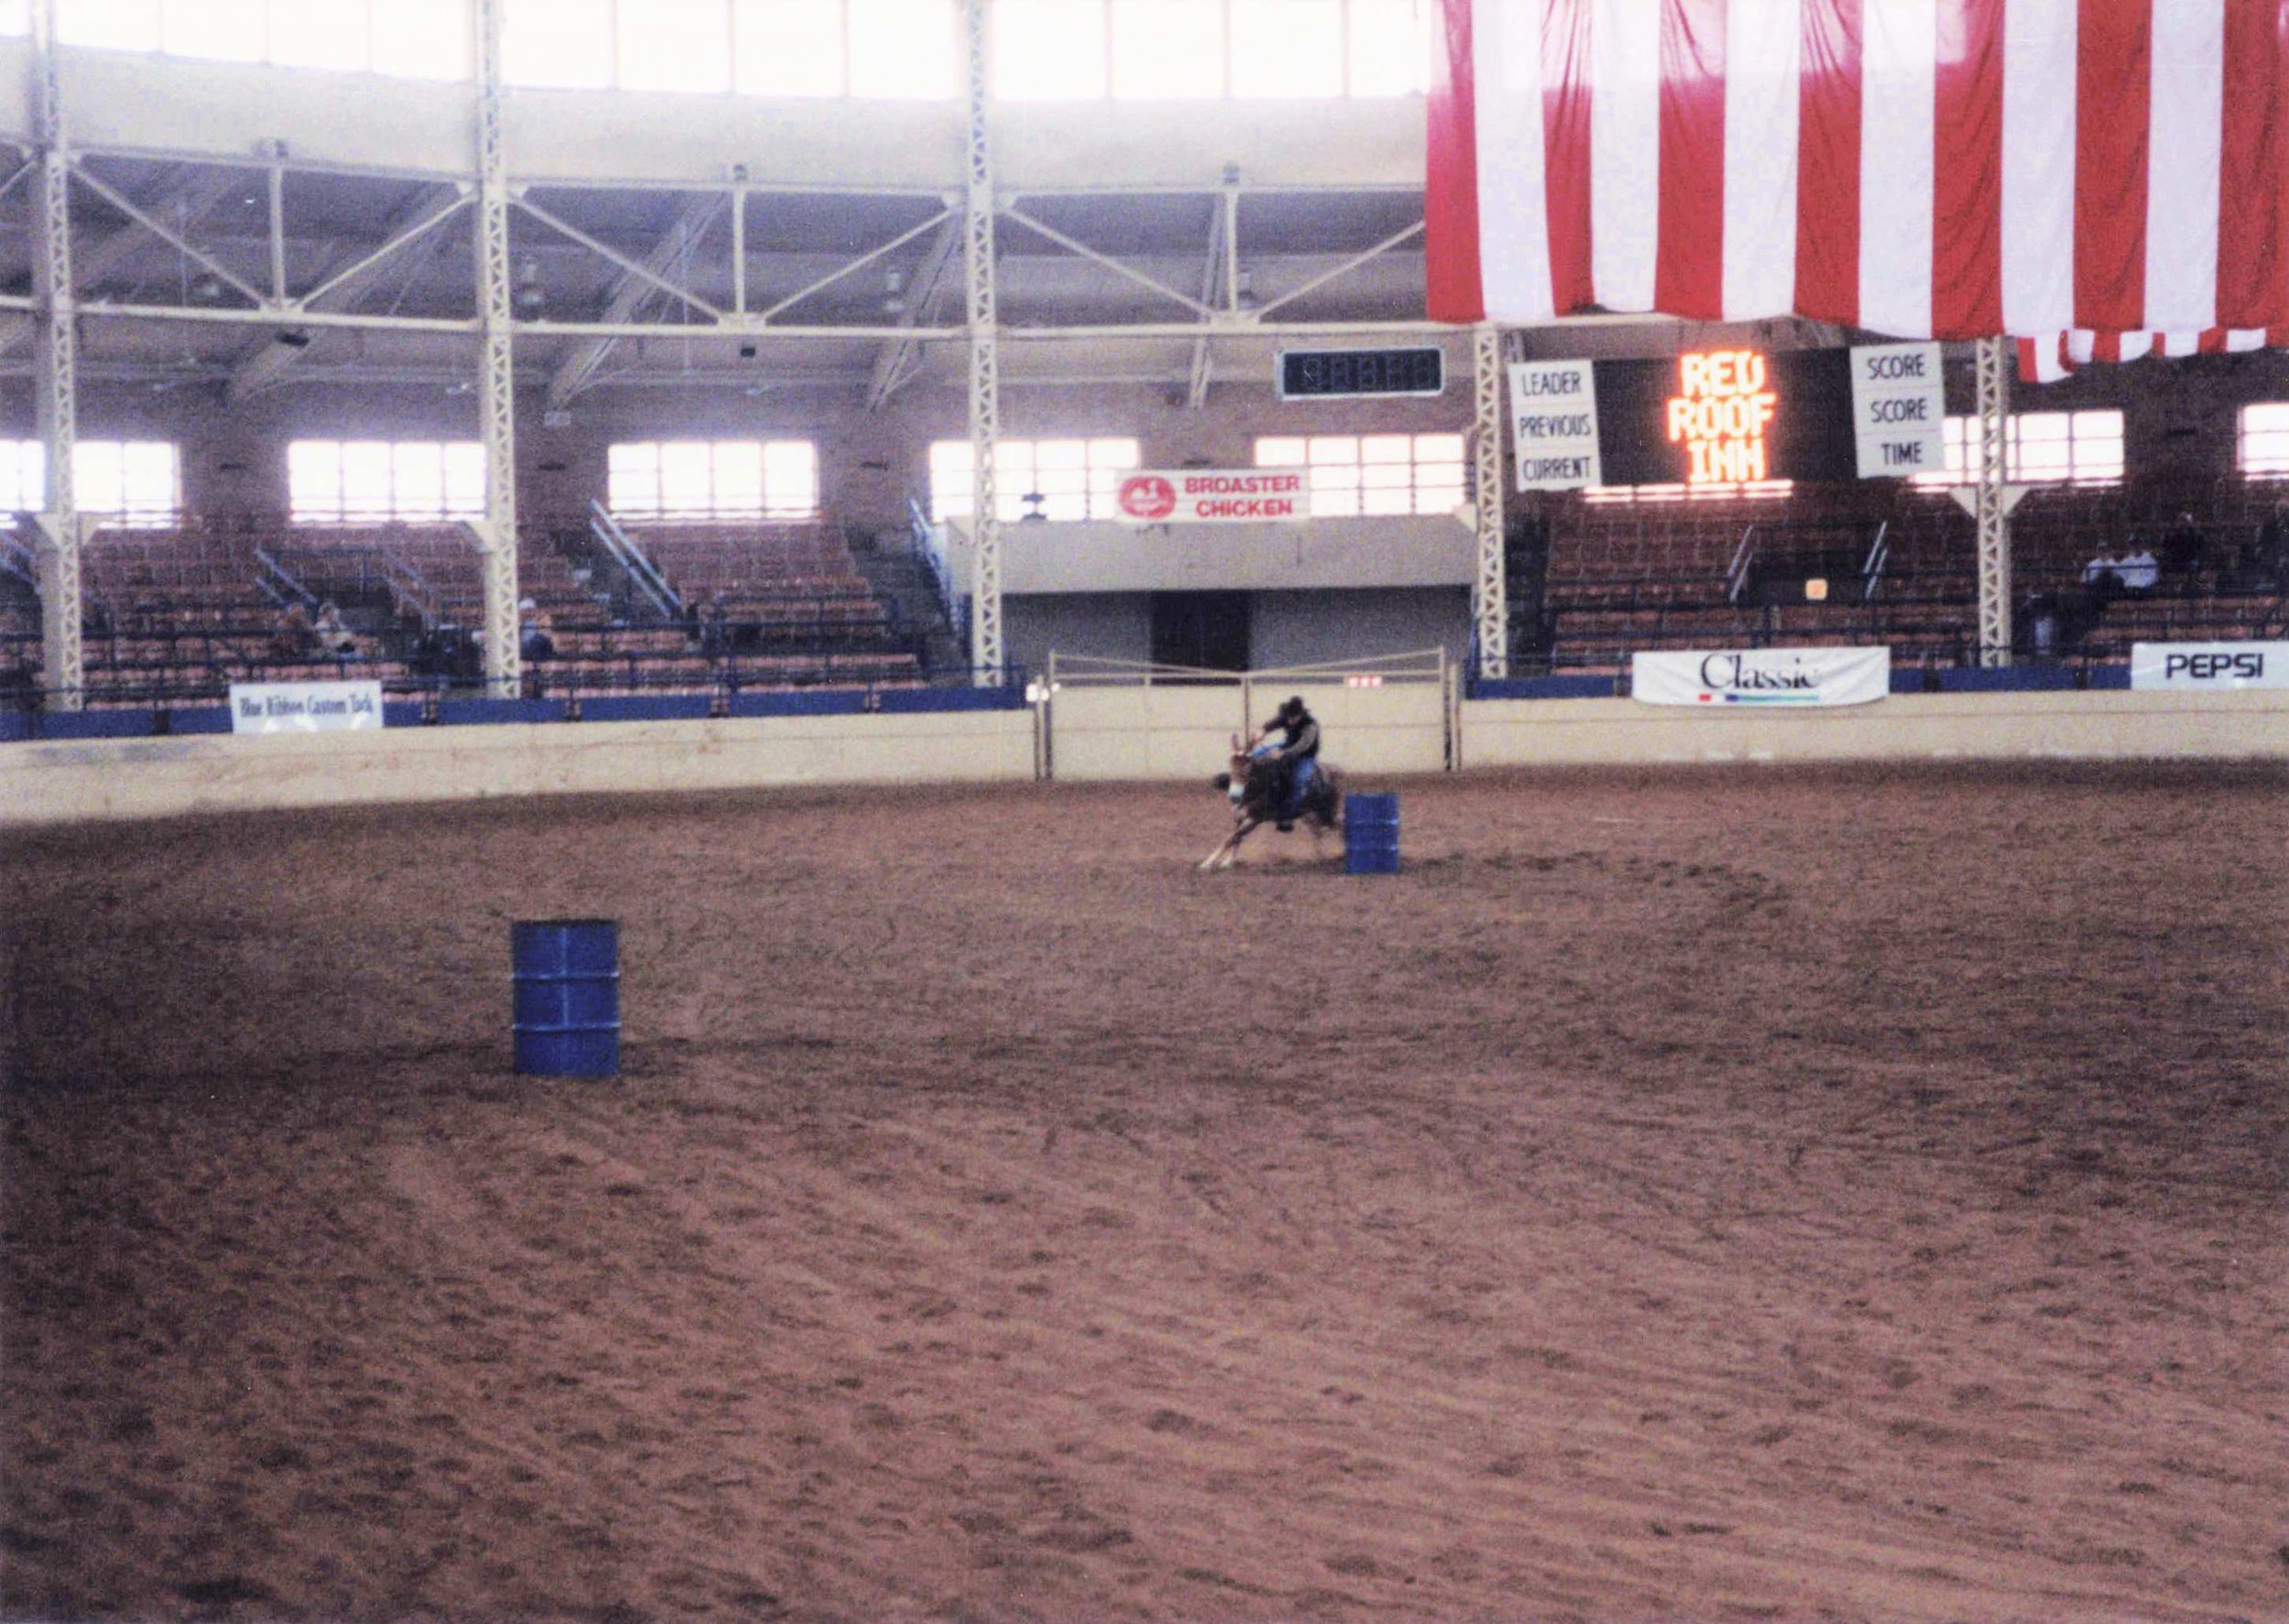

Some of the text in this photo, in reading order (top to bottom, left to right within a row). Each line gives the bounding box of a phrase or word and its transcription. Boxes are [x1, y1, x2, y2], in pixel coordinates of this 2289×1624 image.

[1867, 354, 1926, 380] SCORE
[1523, 371, 1581, 396] LEADER
[1667, 393, 1778, 442] ROOF
[1871, 398, 1927, 423] SCORE
[1519, 414, 1591, 438] PREVIOUS
[1881, 442, 1922, 465] TIME
[1523, 457, 1589, 482] CURRENT
[1184, 475, 1299, 493] BROASTER
[1196, 500, 1292, 517] CHICKEN
[1700, 653, 1820, 689] Classic
[2165, 653, 2263, 679] PEPSI
